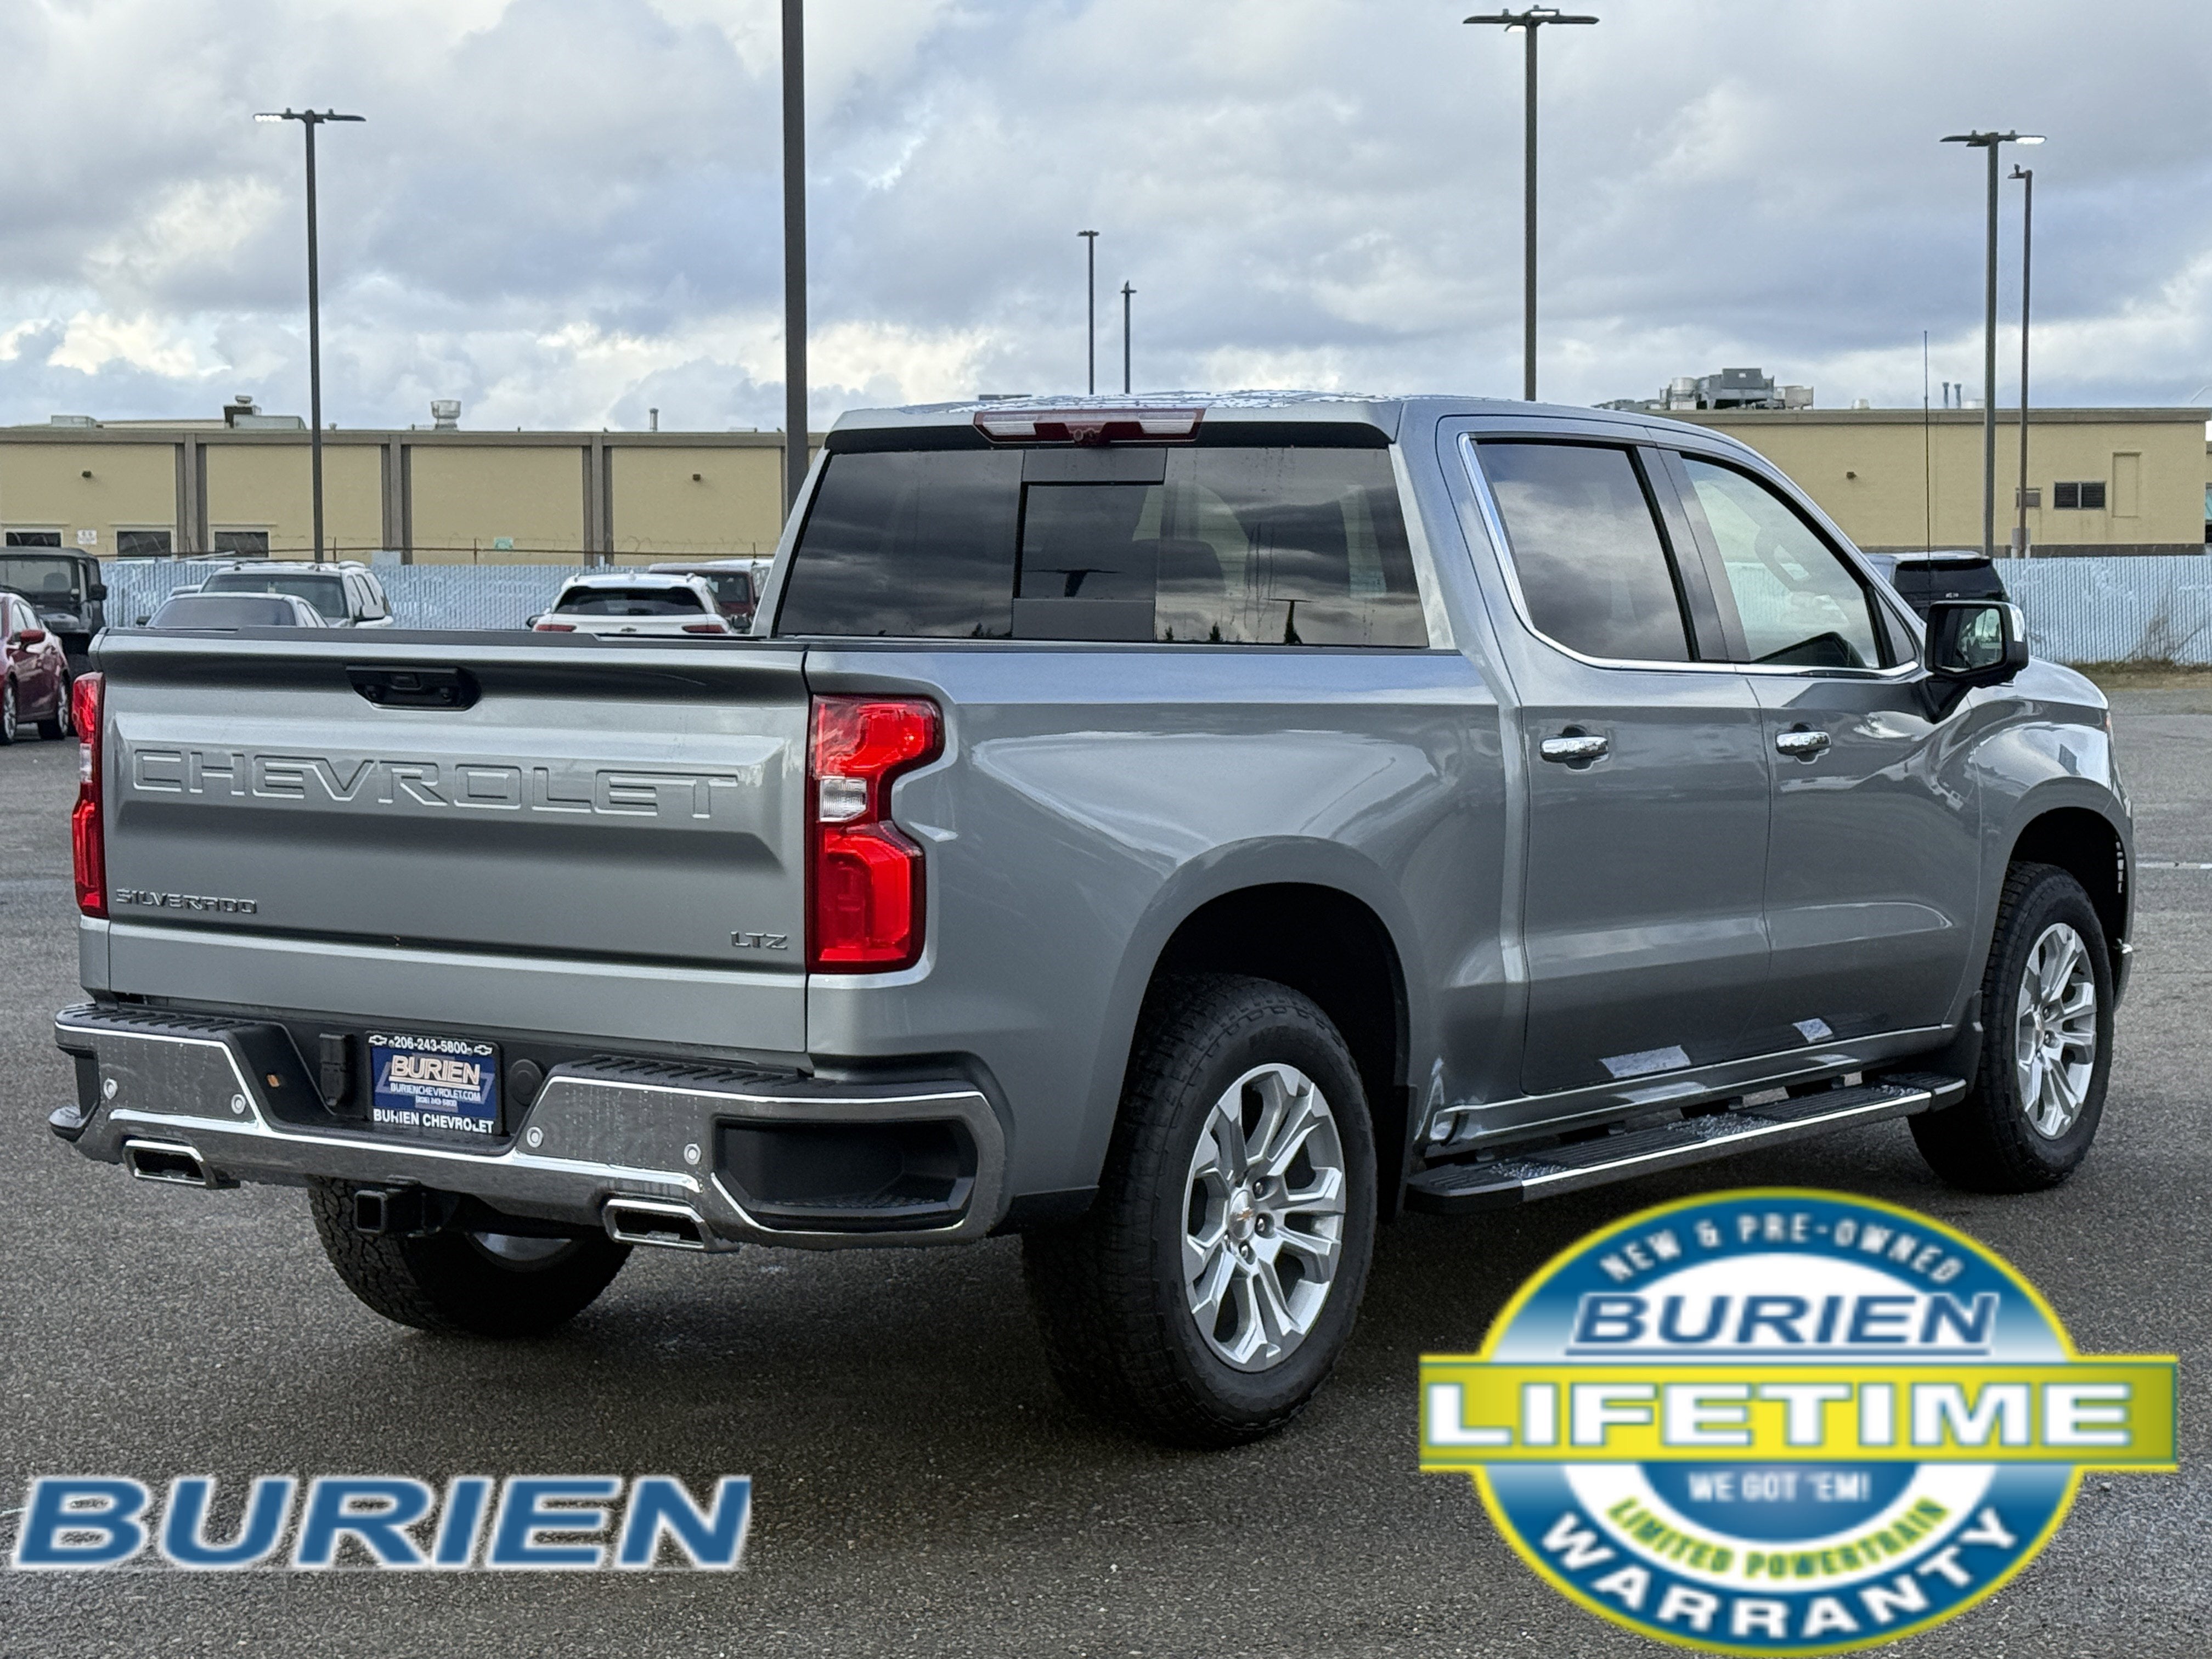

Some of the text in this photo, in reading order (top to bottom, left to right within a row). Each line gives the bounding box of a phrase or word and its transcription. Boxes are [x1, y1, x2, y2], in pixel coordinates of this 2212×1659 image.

[133, 749, 739, 820] CHEVROLET
[116, 888, 257, 913] SILVERADO
[730, 930, 788, 950] LTZ
[394, 1036, 467, 1054] 206-243-5800
[391, 1054, 481, 1085] BURIEN
[373, 1108, 494, 1133] BURIEN CHEVROLET
